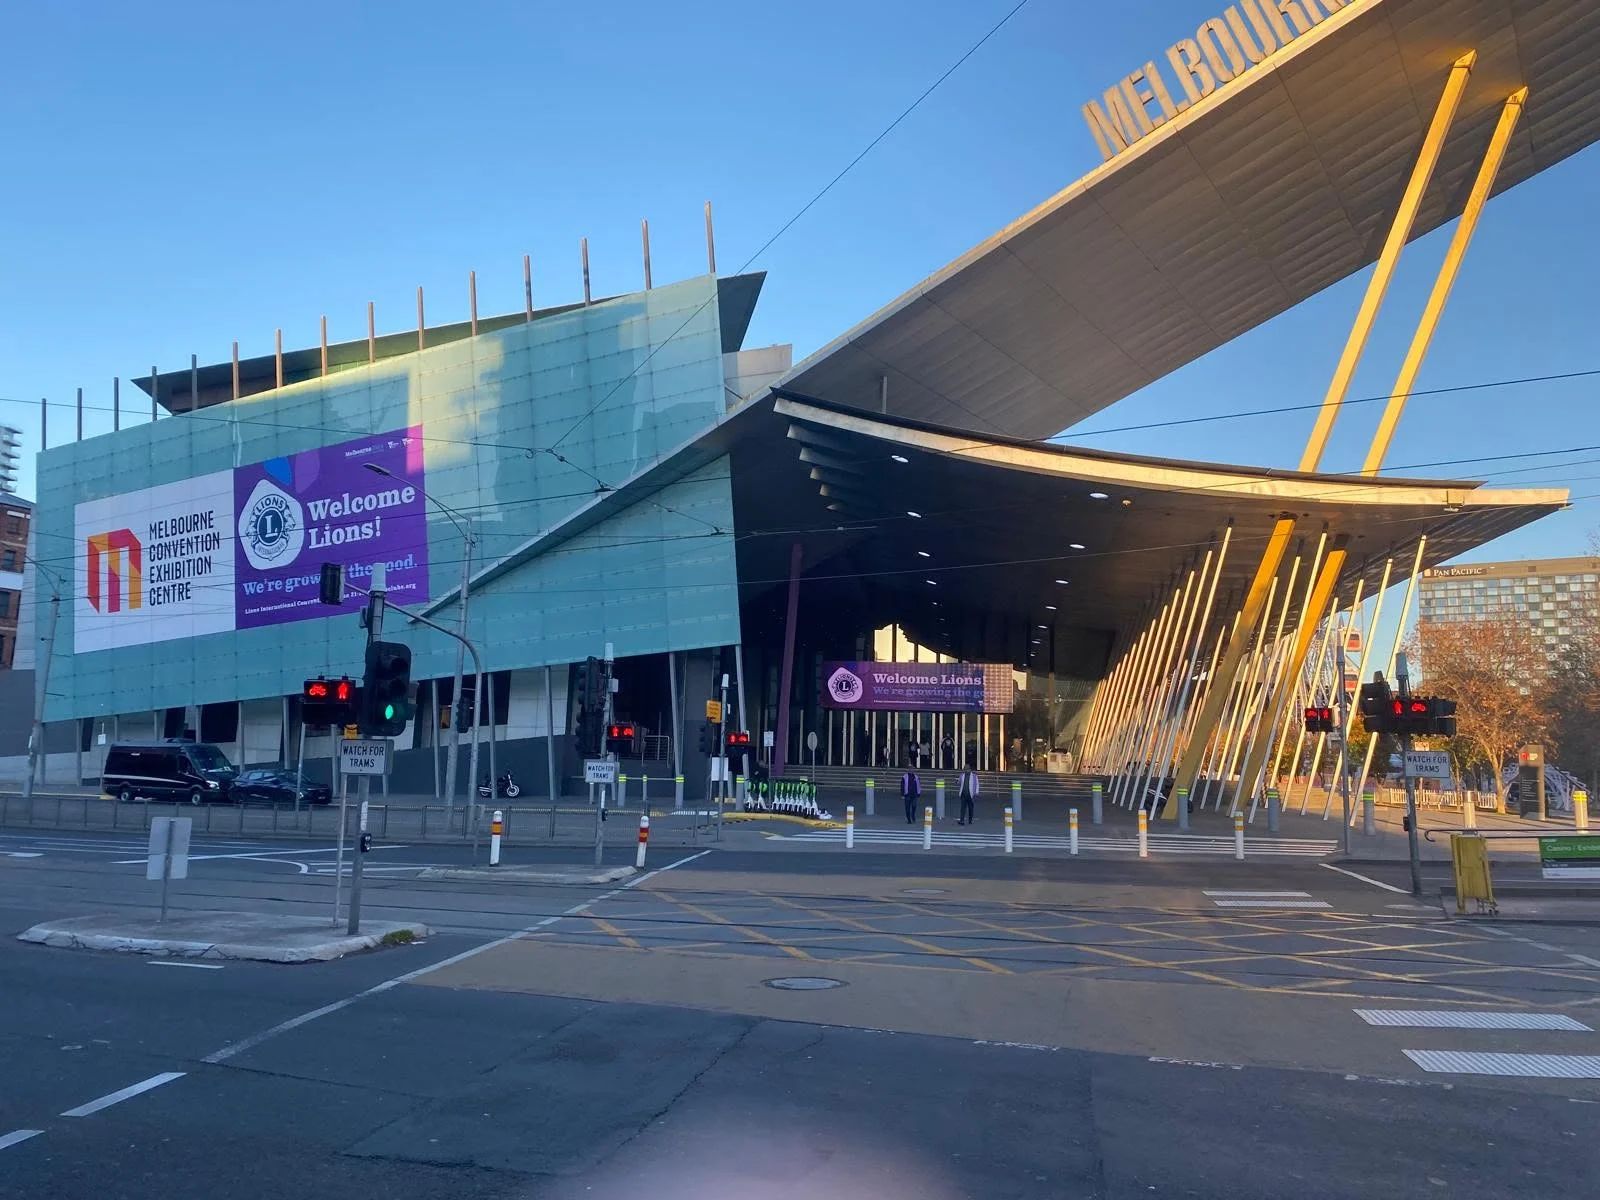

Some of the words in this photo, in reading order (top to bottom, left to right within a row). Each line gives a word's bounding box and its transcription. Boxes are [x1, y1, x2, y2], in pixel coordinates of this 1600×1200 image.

[256, 497, 285, 512] LIONS
[307, 486, 416, 521] Welcome
[149, 510, 214, 541] MELBOURNE
[265, 514, 279, 538] L
[308, 515, 381, 549] Lions!
[149, 532, 220, 562] CONVENTION
[149, 556, 212, 584] EXHIBITION
[243, 578, 283, 596] We're
[348, 562, 374, 579] the
[385, 553, 418, 572] ood.
[1433, 569, 1450, 577] PAN
[1451, 568, 1482, 576] PACIFIC
[149, 581, 192, 606] CENTRE
[873, 673, 938, 684] Welcome
[905, 687, 951, 698] growing
[343, 745, 368, 756] WATCH
[369, 746, 385, 757] FOR
[1406, 755, 1431, 763] WATCH
[1433, 756, 1448, 764] FOR
[350, 758, 375, 768] TRAMS
[1415, 764, 1440, 773] TRAMS
